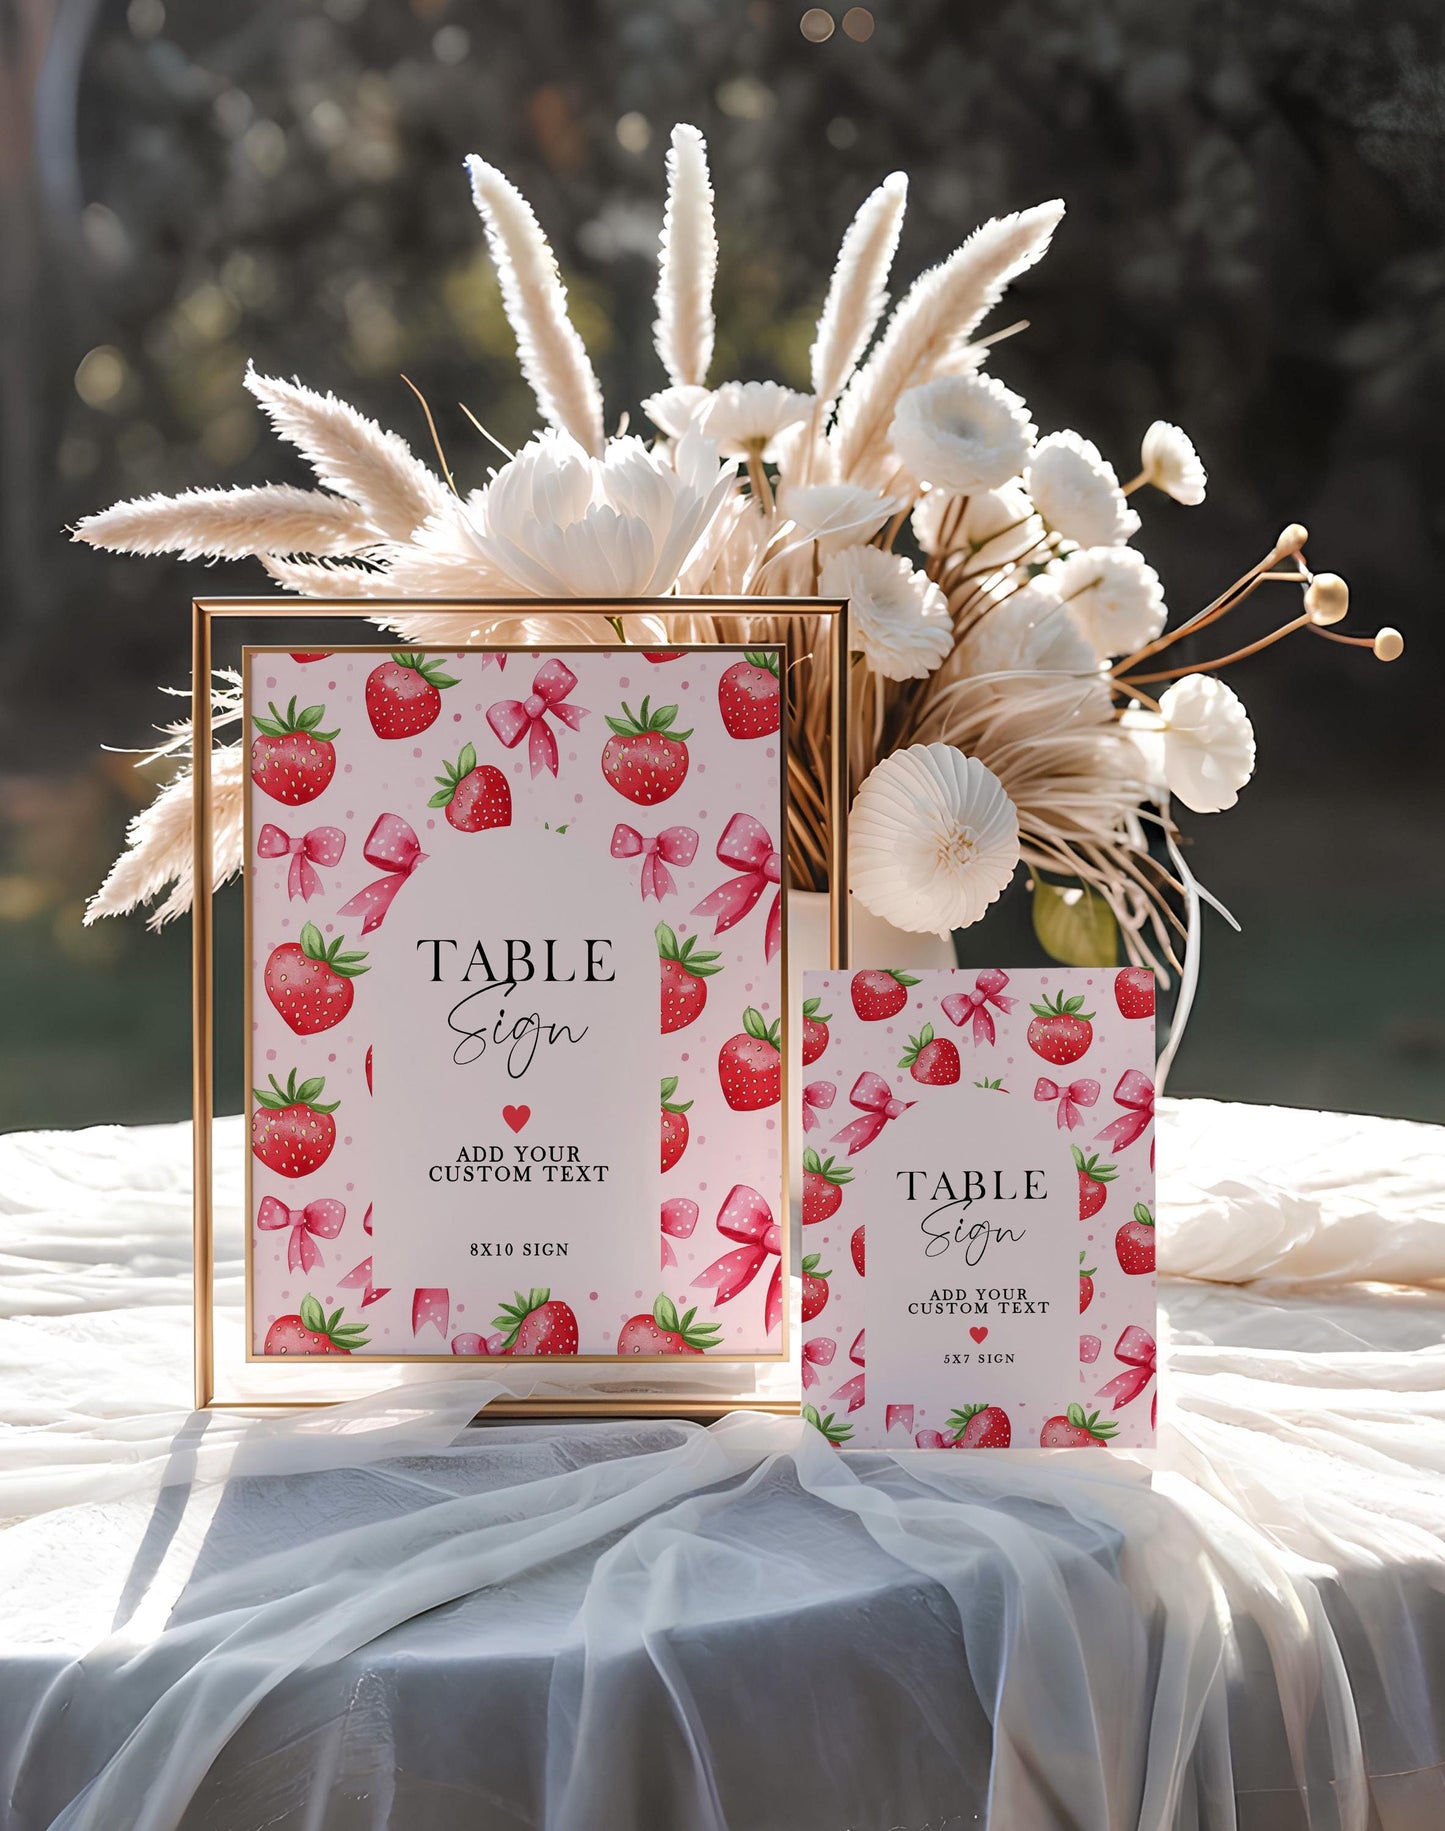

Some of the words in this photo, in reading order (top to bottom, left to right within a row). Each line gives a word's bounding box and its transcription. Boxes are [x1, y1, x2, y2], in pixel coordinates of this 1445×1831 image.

[416, 939, 616, 983] TABLE
[448, 981, 589, 1079] Sign
[456, 1146, 504, 1163] ADD
[514, 1145, 581, 1163] YOUR
[428, 1165, 532, 1183] CUSTOM
[543, 1165, 610, 1183] TEXT
[896, 1170, 1048, 1200] TABLE
[921, 1199, 1026, 1266] Sign
[470, 1243, 514, 1257] 8X10
[522, 1242, 569, 1257] SIGN
[929, 1289, 967, 1301] ADD
[976, 1288, 1028, 1301] YOUR
[908, 1302, 988, 1315] CUSTOM
[998, 1301, 1050, 1314] TEXT
[943, 1354, 970, 1364] 5X7
[978, 1353, 1016, 1364] SIGN
